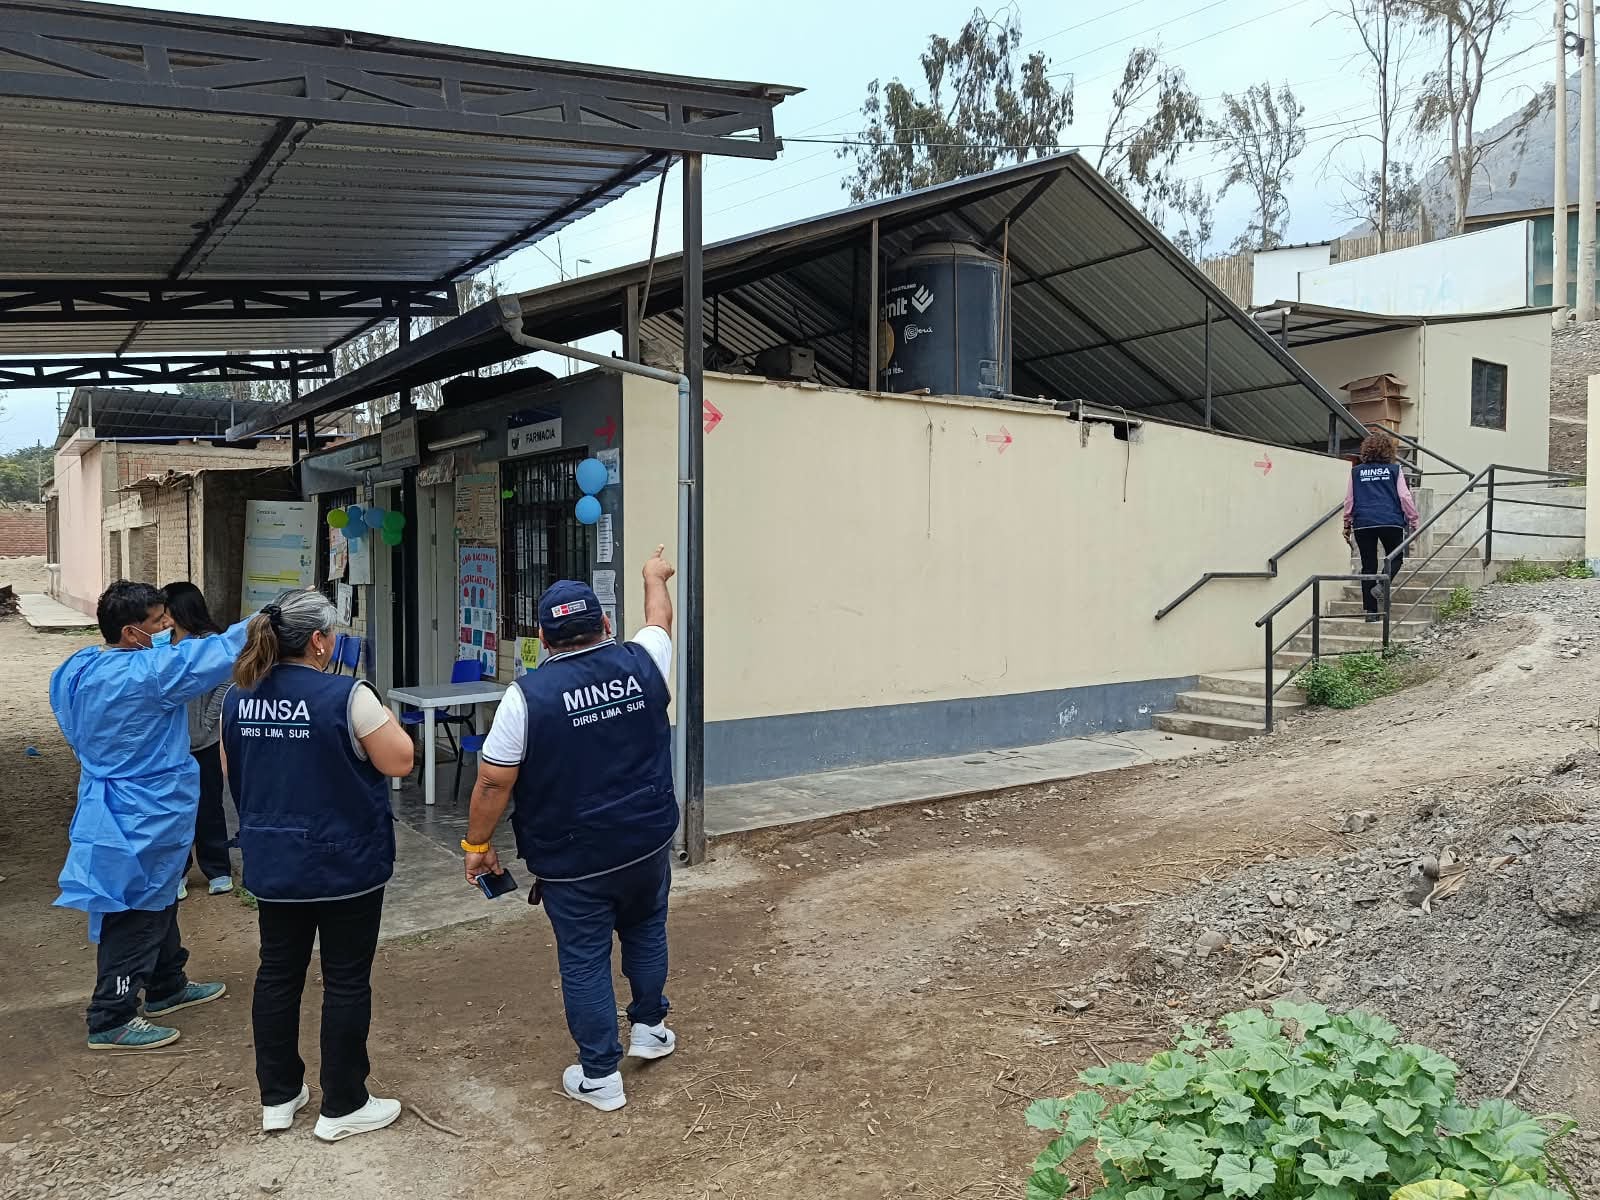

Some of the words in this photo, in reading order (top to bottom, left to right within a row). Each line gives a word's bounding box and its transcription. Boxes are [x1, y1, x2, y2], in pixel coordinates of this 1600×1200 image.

[526, 428, 556, 444] FARMACIA
[1360, 468, 1390, 476] MINSA
[562, 675, 643, 712] MINSA
[238, 698, 311, 721] MINSA
[572, 712, 599, 727] DIRIS
[600, 706, 622, 720] LIMA
[626, 700, 646, 713] SUR
[240, 727, 261, 737] DIRIS
[265, 727, 284, 738] LIMA
[289, 729, 310, 739] SUR
